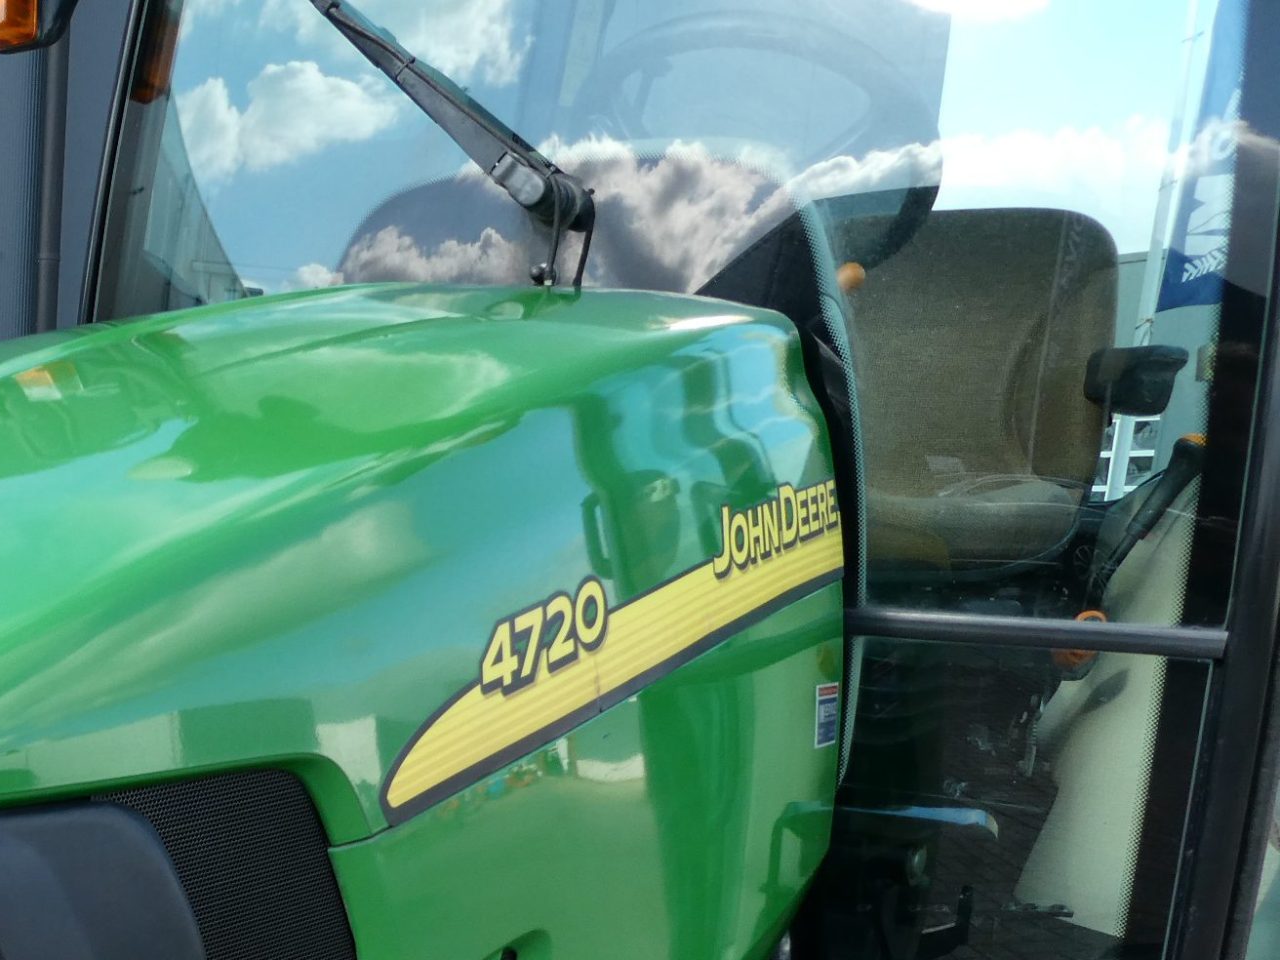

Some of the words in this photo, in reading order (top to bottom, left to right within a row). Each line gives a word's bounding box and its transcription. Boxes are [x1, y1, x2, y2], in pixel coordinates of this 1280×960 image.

[713, 502, 780, 579] JOHN
[778, 480, 839, 550] DEERE
[481, 576, 607, 695] 4720
